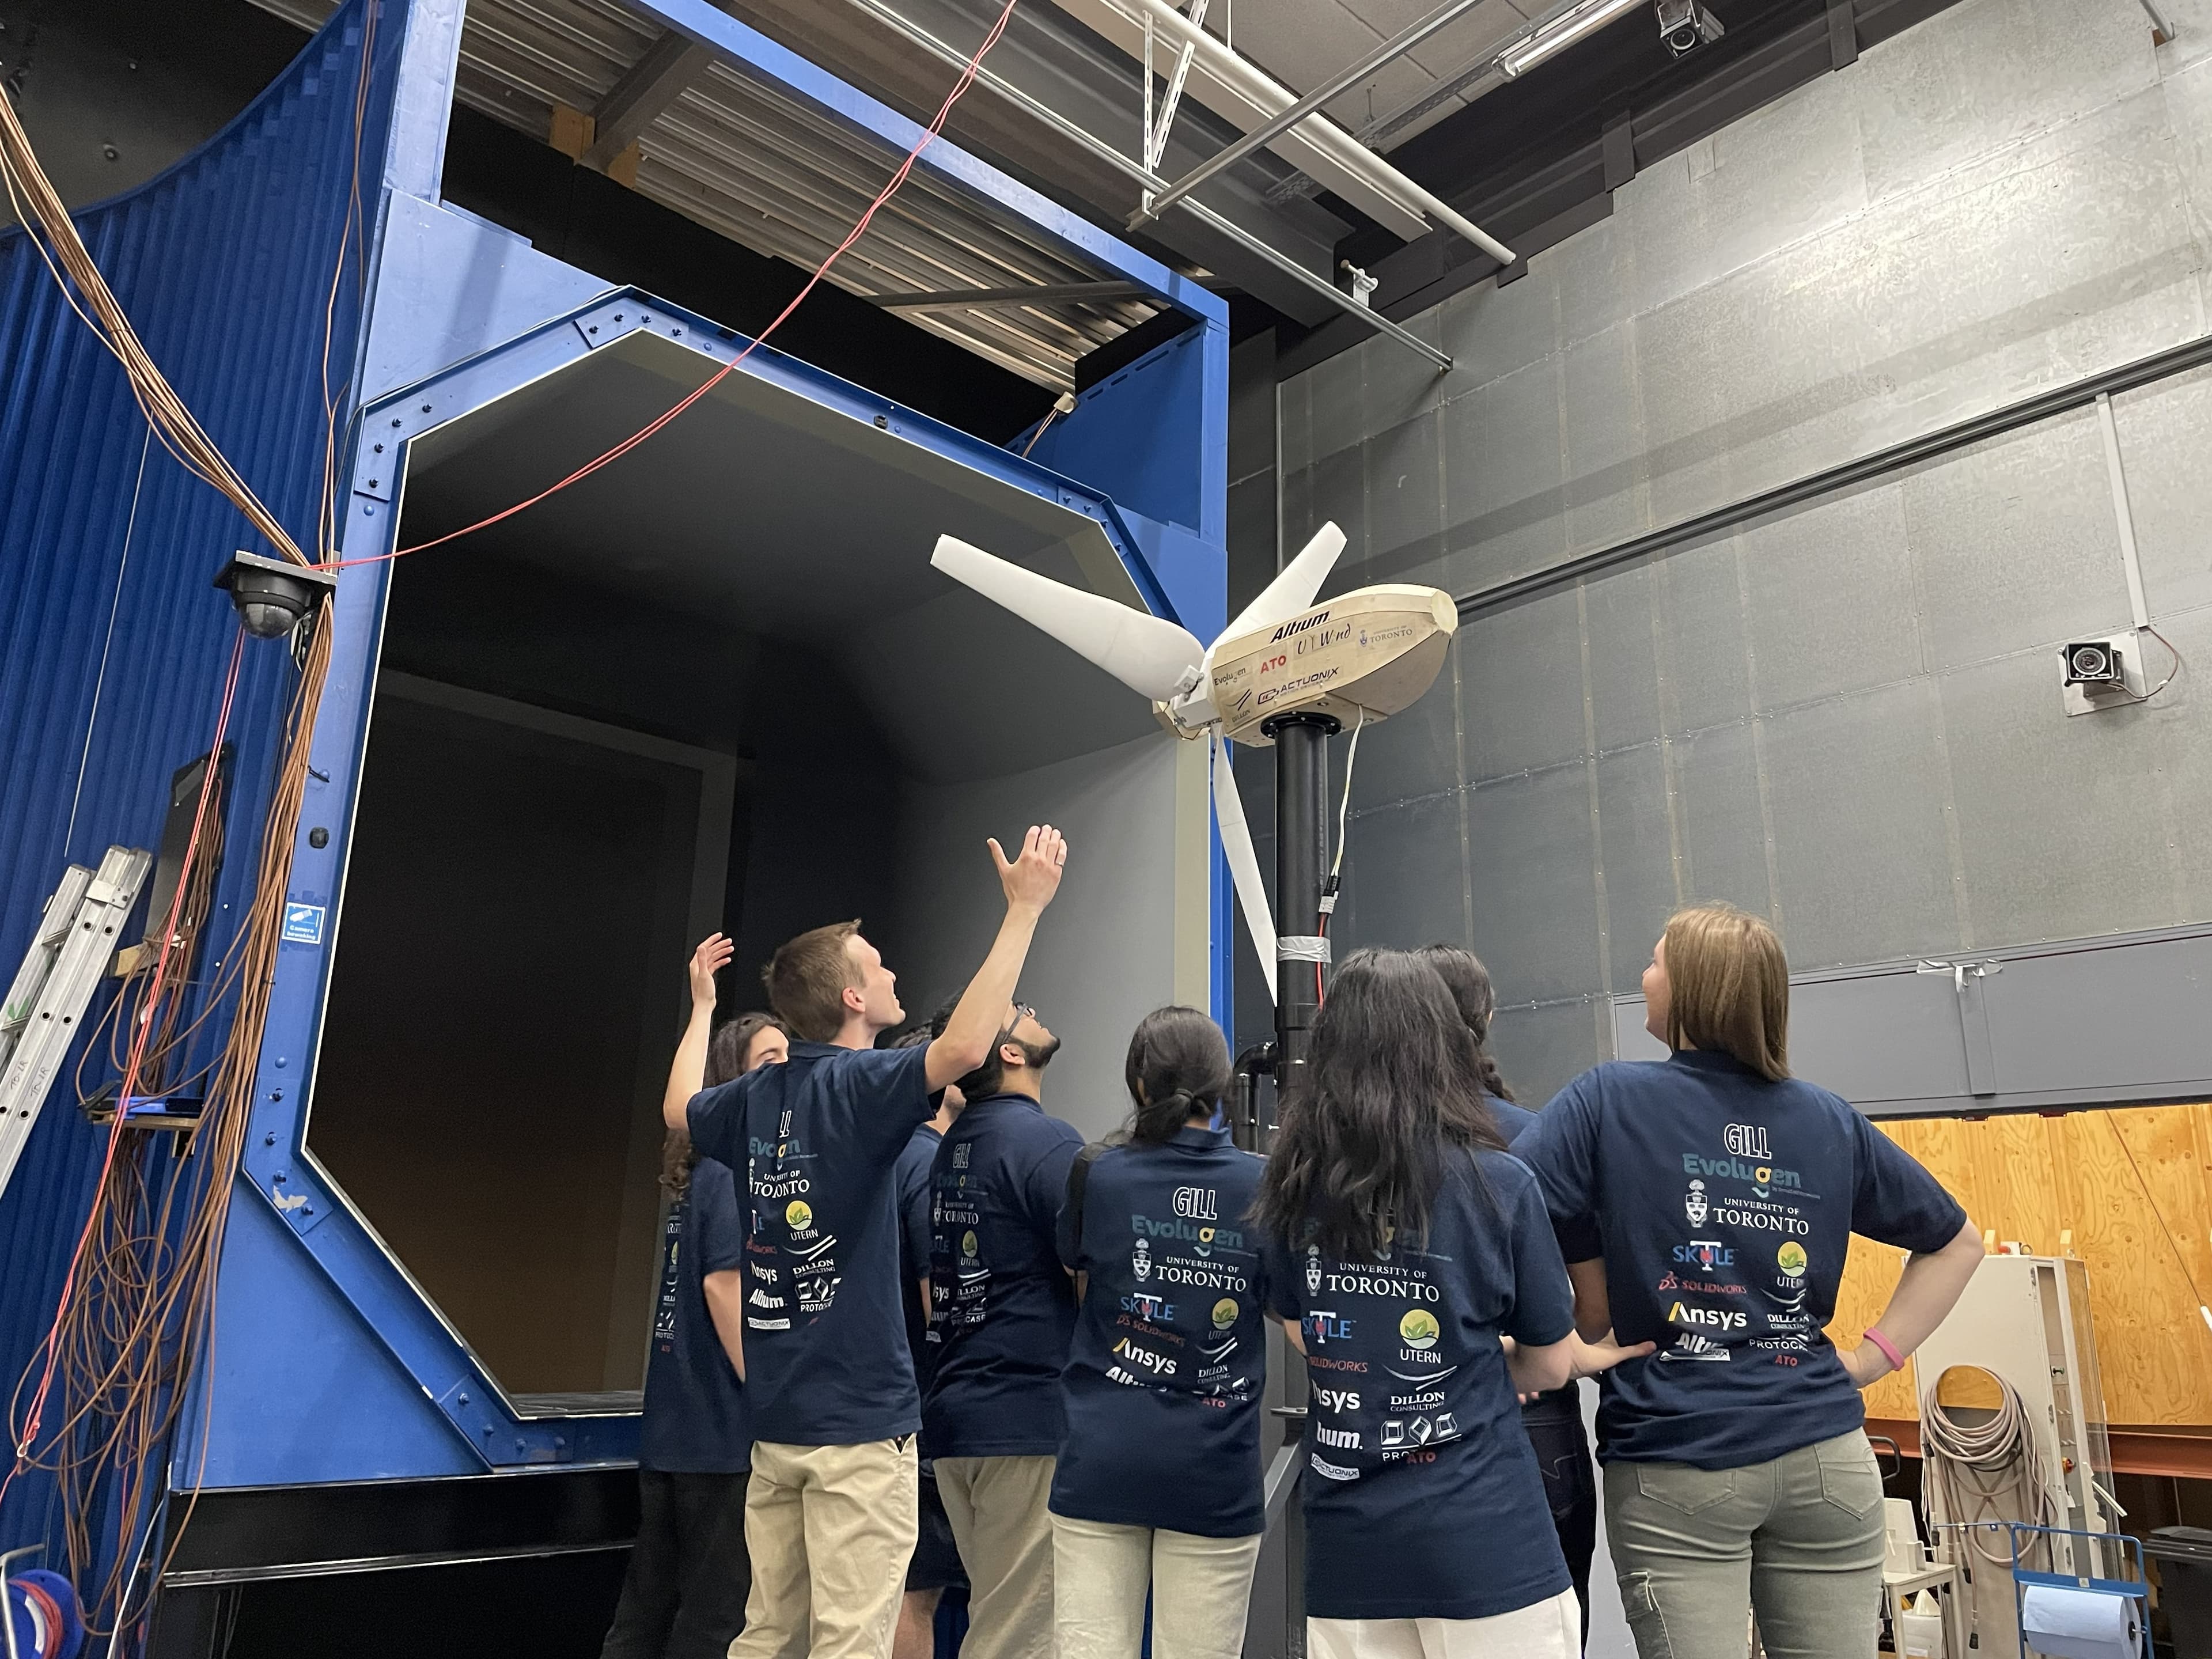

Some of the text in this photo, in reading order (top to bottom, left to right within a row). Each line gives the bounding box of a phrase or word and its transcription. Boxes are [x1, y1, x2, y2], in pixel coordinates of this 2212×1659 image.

[1370, 628, 1413, 643] TORONTO
[1260, 655, 1286, 674] ATO
[1214, 667, 1246, 686] Evolugen
[1280, 666, 1339, 693] ACTUONIX
[1724, 1123, 1772, 1160] GILL
[1682, 1153, 1801, 1198] Evolugen
[1173, 1186, 1217, 1221] GILL
[1724, 1197, 1799, 1215] UNIVERSITY OF
[1713, 1207, 1809, 1236] TORONTO
[790, 1229, 819, 1241] UTERN
[1131, 1214, 1243, 1257] Evolugen
[793, 1259, 834, 1275] DILLON
[1166, 1256, 1240, 1273] UNIVERSITY OF
[1339, 1263, 1427, 1279] UNIVERSITY OF
[1156, 1265, 1247, 1292] TORONTO
[1681, 1280, 1747, 1294] SOLIDWORKS
[1326, 1274, 1440, 1302] TORONTO
[1668, 1301, 1747, 1331] Ansys
[1112, 1337, 1177, 1374] Ansys
[1400, 1349, 1441, 1364] UTERN
[1775, 1354, 1798, 1367] ATO
[1198, 1364, 1228, 1378] DILLON
[1202, 1397, 1226, 1408] ATO
[1390, 1400, 1445, 1412] CONSULTING
[1391, 1391, 1445, 1405] DILLON
[1406, 1451, 1436, 1464] ATO
